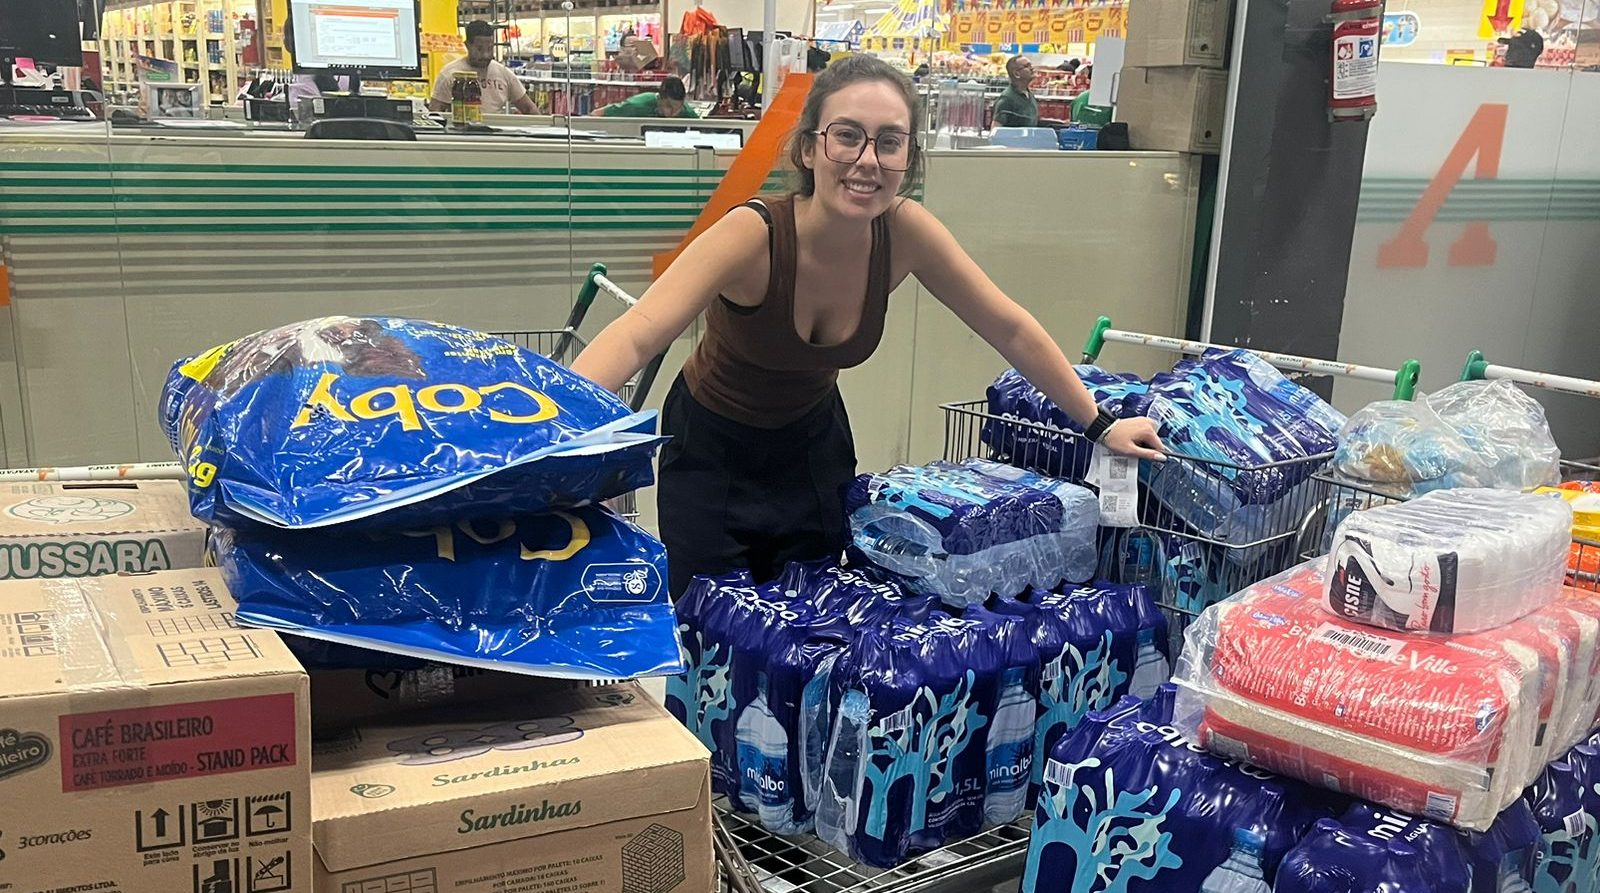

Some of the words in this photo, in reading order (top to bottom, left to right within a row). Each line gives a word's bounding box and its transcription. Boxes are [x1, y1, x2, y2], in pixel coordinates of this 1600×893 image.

[290, 372, 560, 432] Coby
[1410, 650, 1458, 676] Ville
[72, 719, 115, 750] CAFÉ
[121, 715, 213, 744] BRASILEIRO
[73, 752, 107, 769] EXTRA
[112, 747, 146, 765] FORTE
[196, 747, 246, 772] STAND
[250, 743, 290, 765] PACK
[432, 754, 581, 788] Sardinhas
[457, 799, 582, 835] Sardinhas
